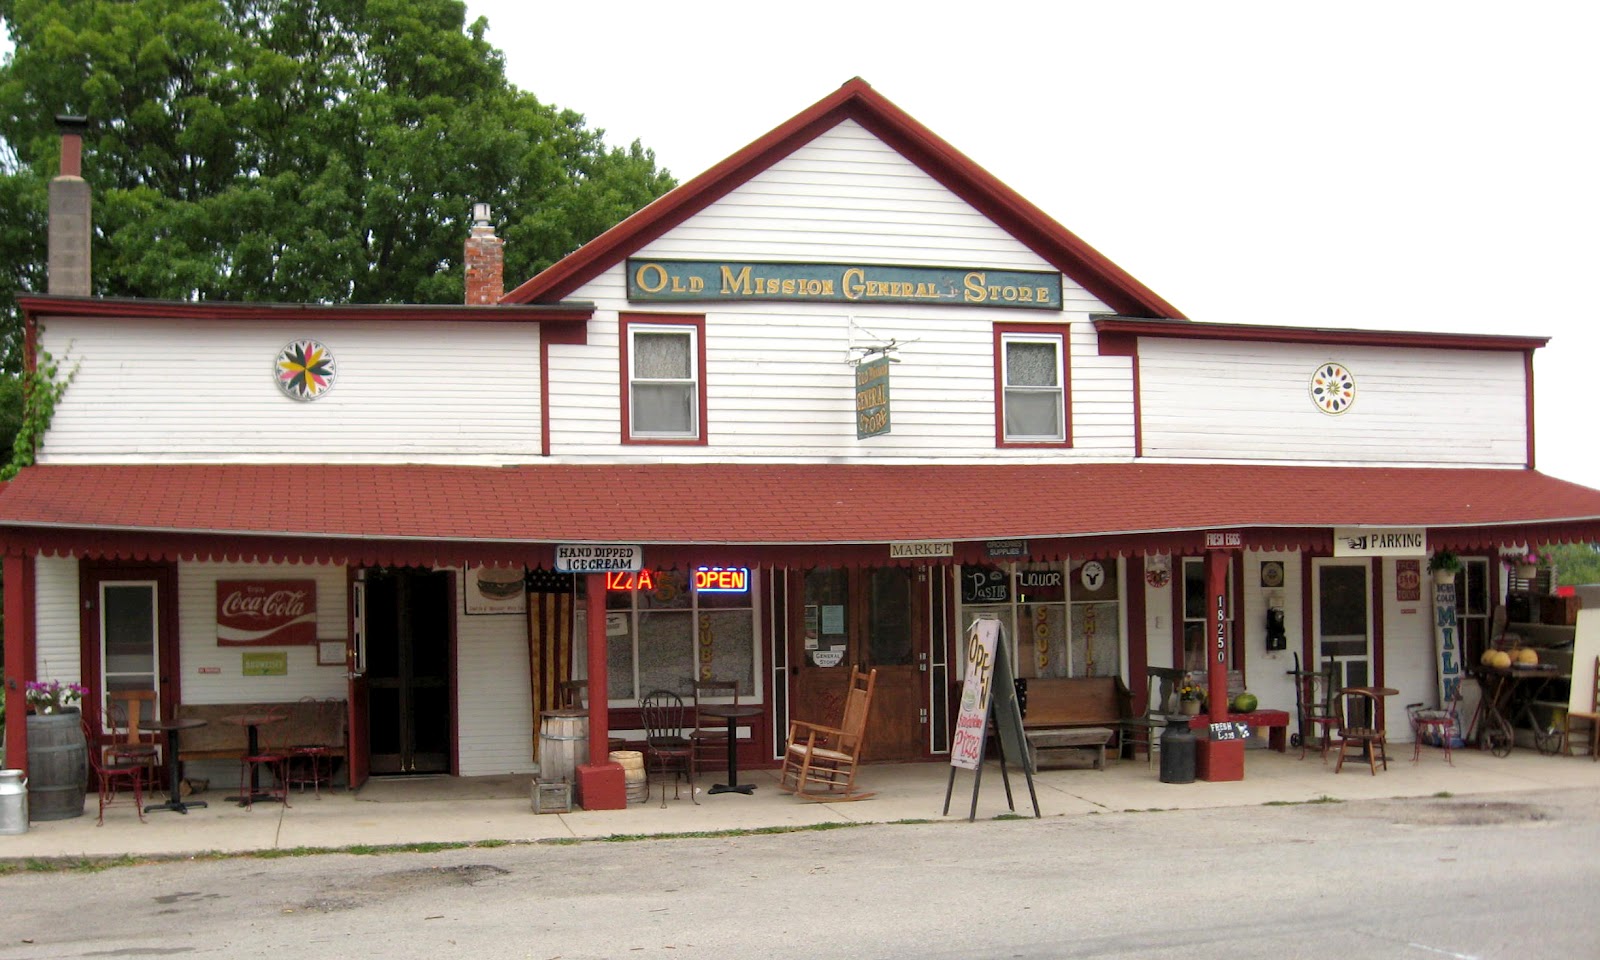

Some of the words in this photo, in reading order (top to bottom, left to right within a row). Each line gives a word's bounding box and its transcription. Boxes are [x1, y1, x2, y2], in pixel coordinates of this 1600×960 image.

[636, 263, 704, 293] OLD
[720, 265, 834, 295] MISSION
[842, 267, 939, 299] GENERAL
[964, 272, 1050, 303] STORE
[857, 384, 886, 411] GENERAL
[559, 547, 592, 558] HAND
[594, 547, 634, 558] DIPPED
[892, 543, 952, 556] MARKET
[1207, 533, 1224, 546] FRESH
[1225, 533, 1240, 546] EGGS
[1371, 533, 1421, 548] PARKING
[696, 571, 744, 589] OPEN
[1017, 572, 1061, 587] LIQUOR
[222, 591, 306, 617] Coca-Cola
[1036, 604, 1049, 670] SOUP
[1217, 595, 1225, 662] 18250
[700, 614, 713, 680] SUBS
[1437, 606, 1463, 702] MILK
[969, 633, 990, 710] OPEN
[1210, 722, 1232, 732] FRESH
